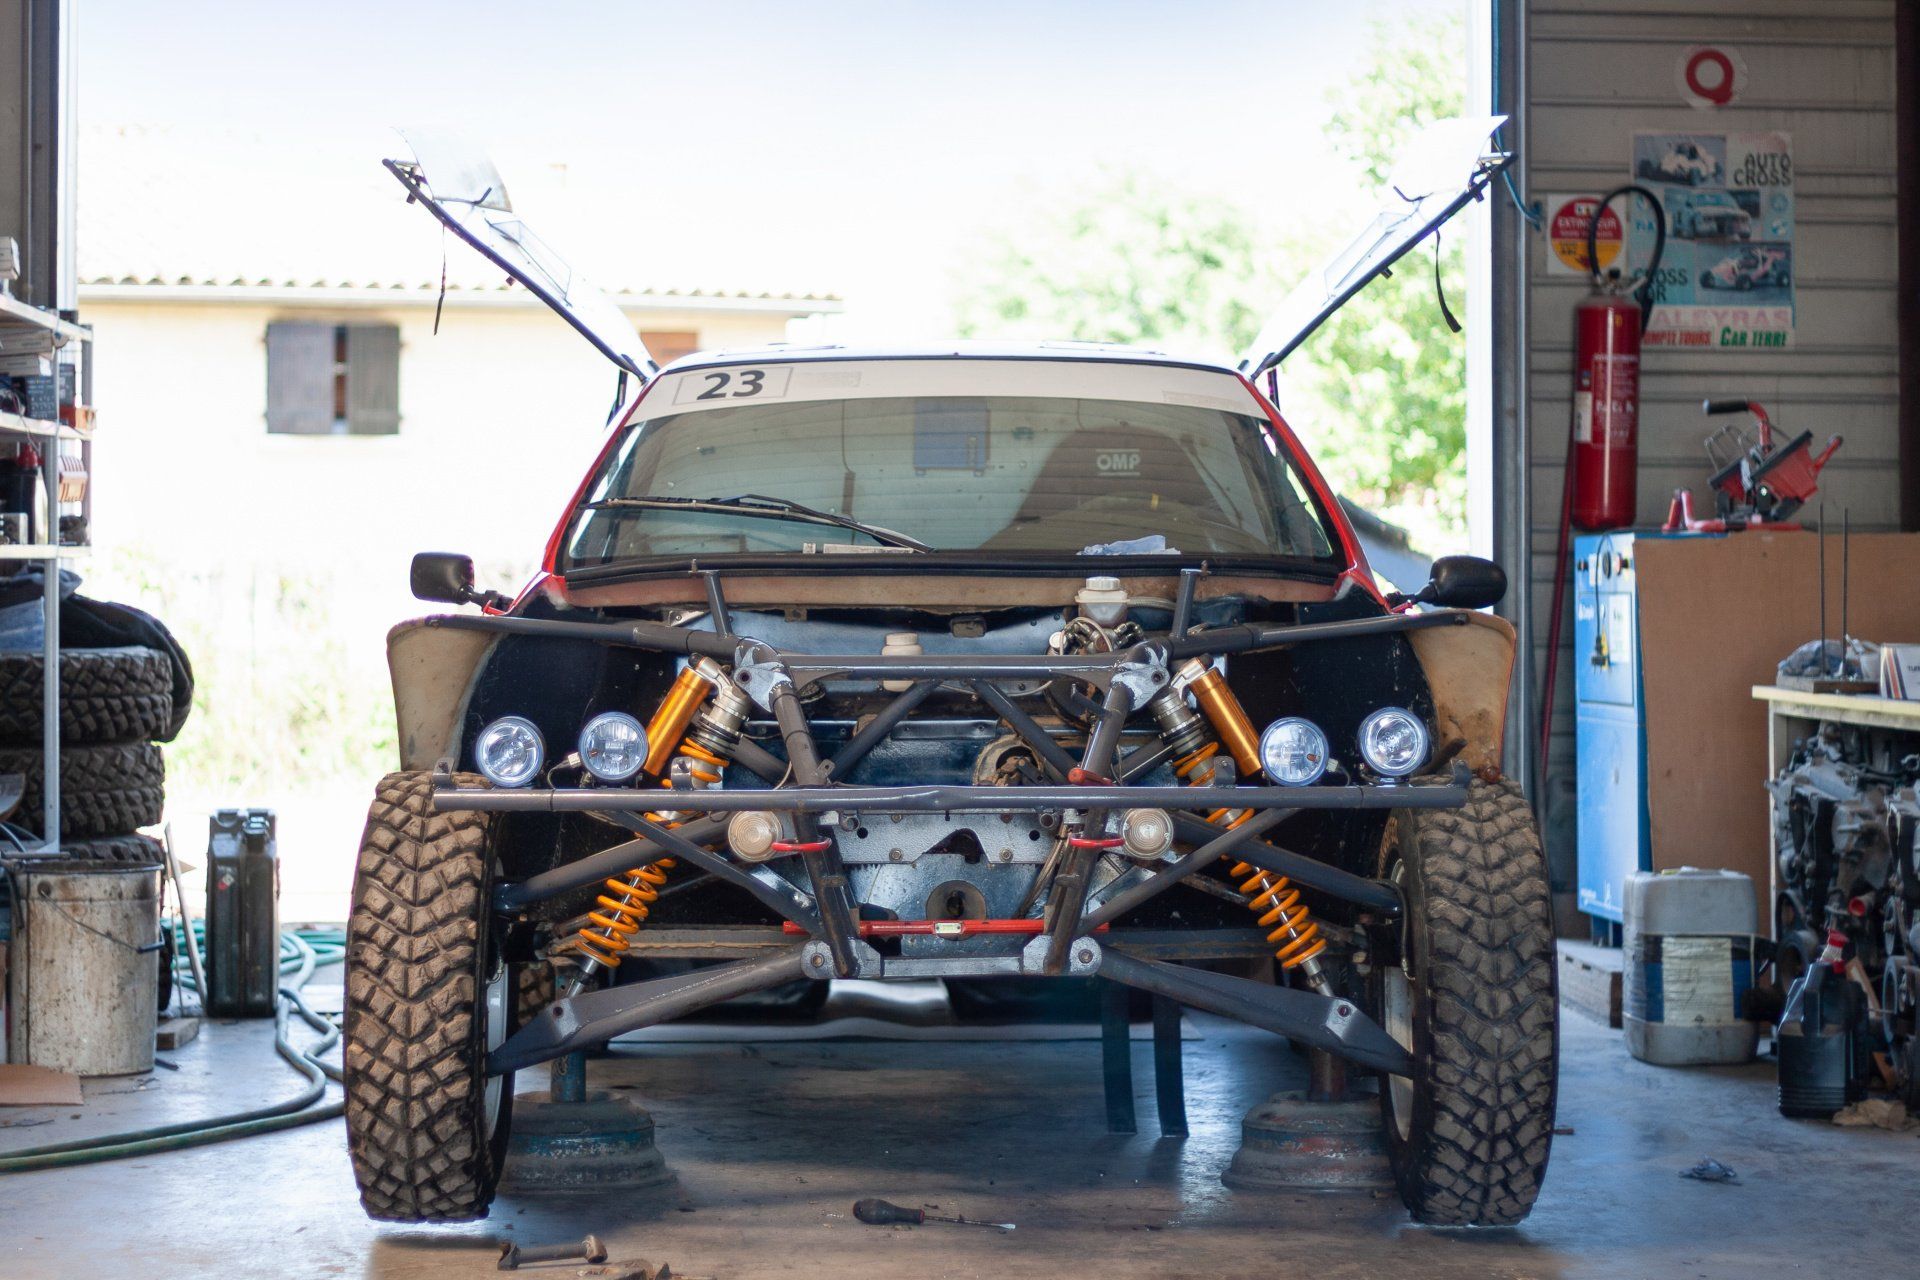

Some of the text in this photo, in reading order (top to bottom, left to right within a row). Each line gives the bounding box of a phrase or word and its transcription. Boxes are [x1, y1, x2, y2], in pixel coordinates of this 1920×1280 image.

[1744, 152, 1791, 171] AUTO
[1733, 168, 1791, 186] CROSS
[1633, 268, 1689, 287] COSS
[1653, 309, 1789, 326] ALEYRAS
[697, 370, 765, 400] 23
[1096, 454, 1141, 470] OMP
